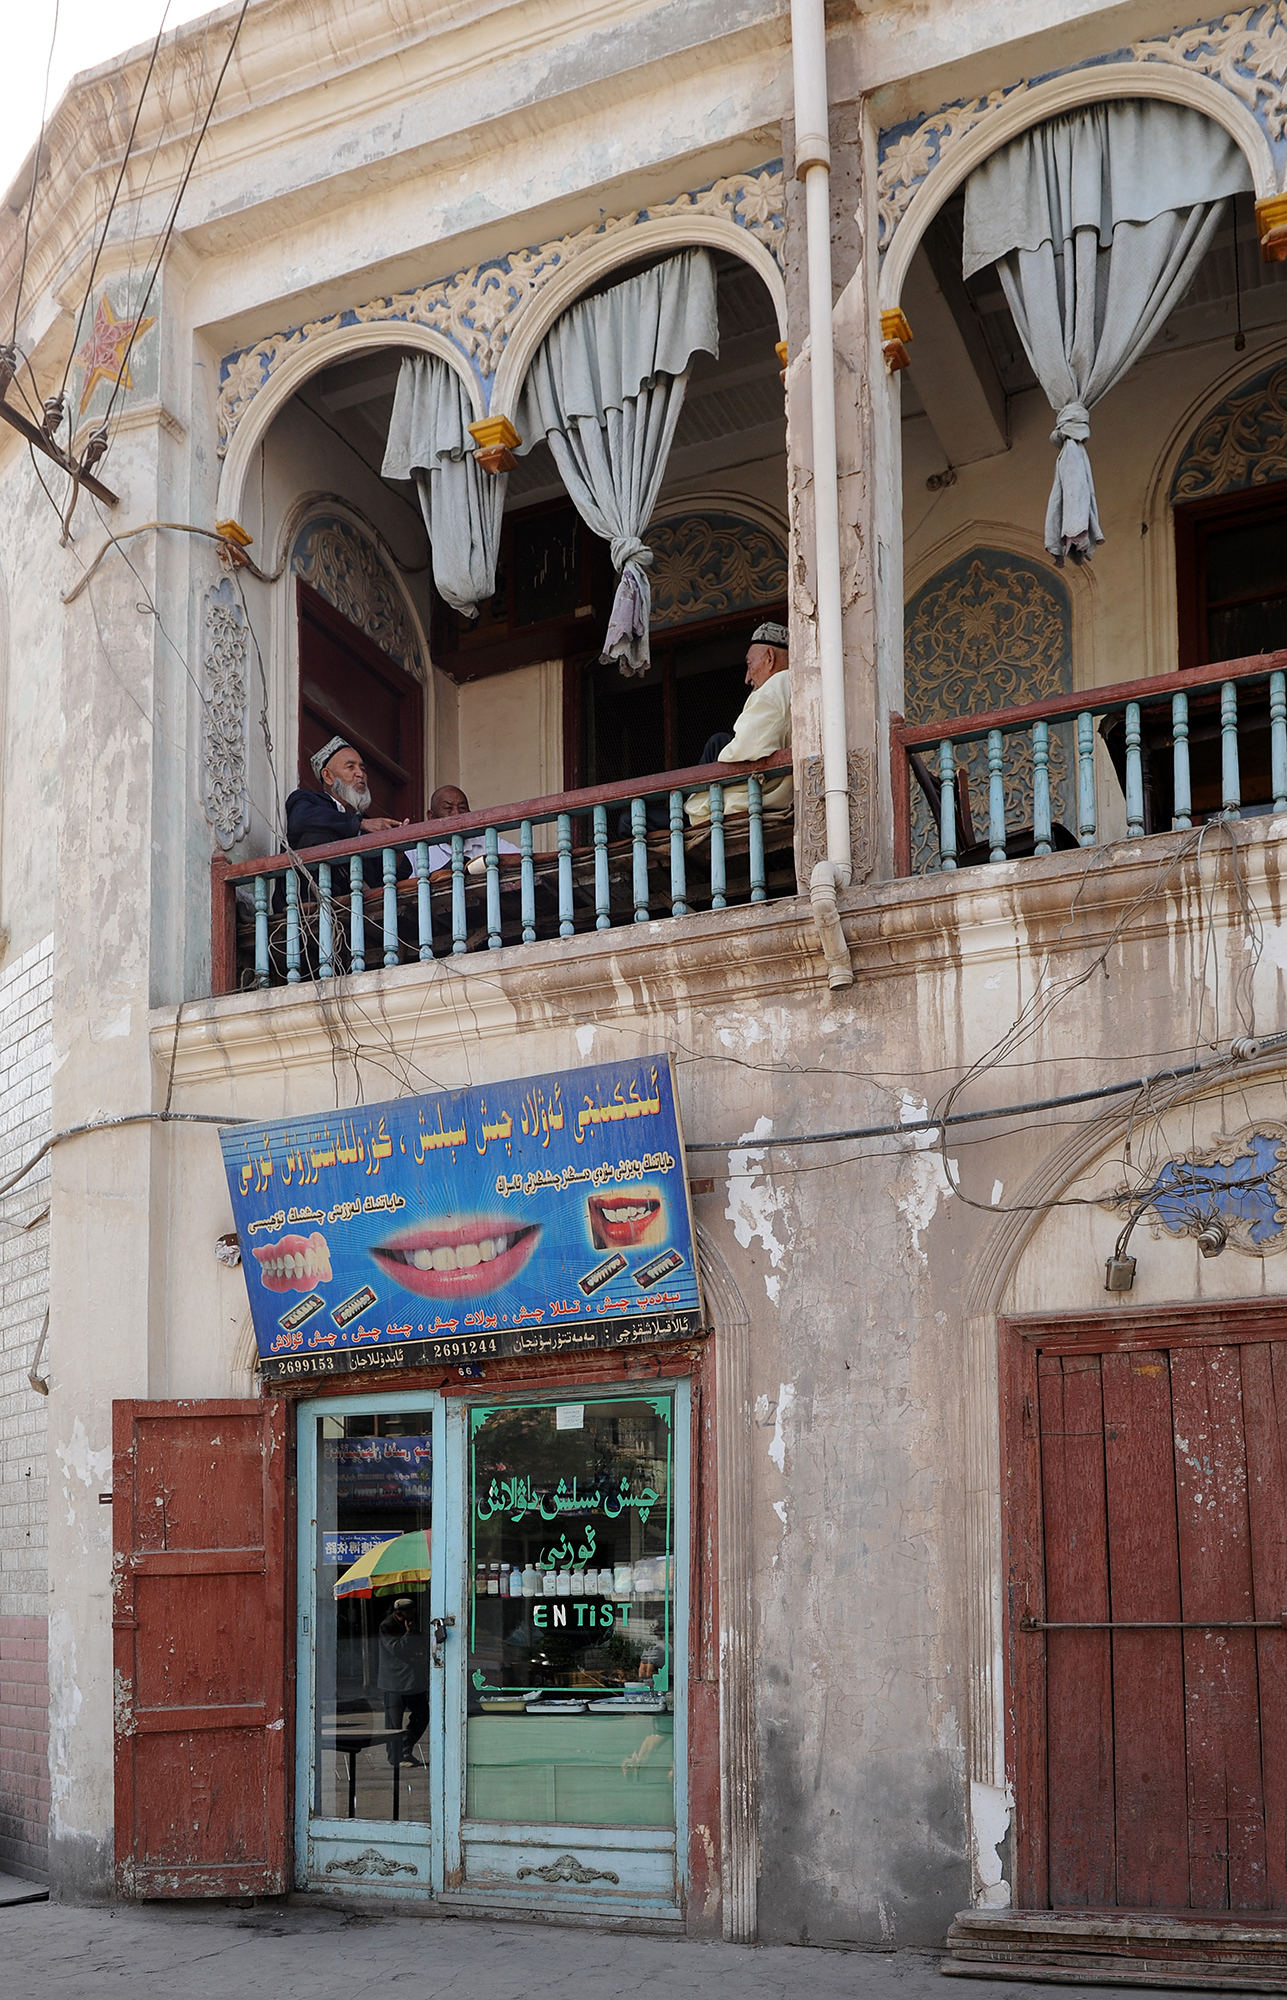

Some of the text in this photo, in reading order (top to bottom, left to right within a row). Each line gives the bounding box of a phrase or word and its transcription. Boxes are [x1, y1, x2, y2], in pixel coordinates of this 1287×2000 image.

[475, 1099, 513, 1157] چىش
[433, 1338, 497, 1358] 2691244
[278, 1357, 335, 1375] 2699153
[458, 1366, 472, 1376] 66
